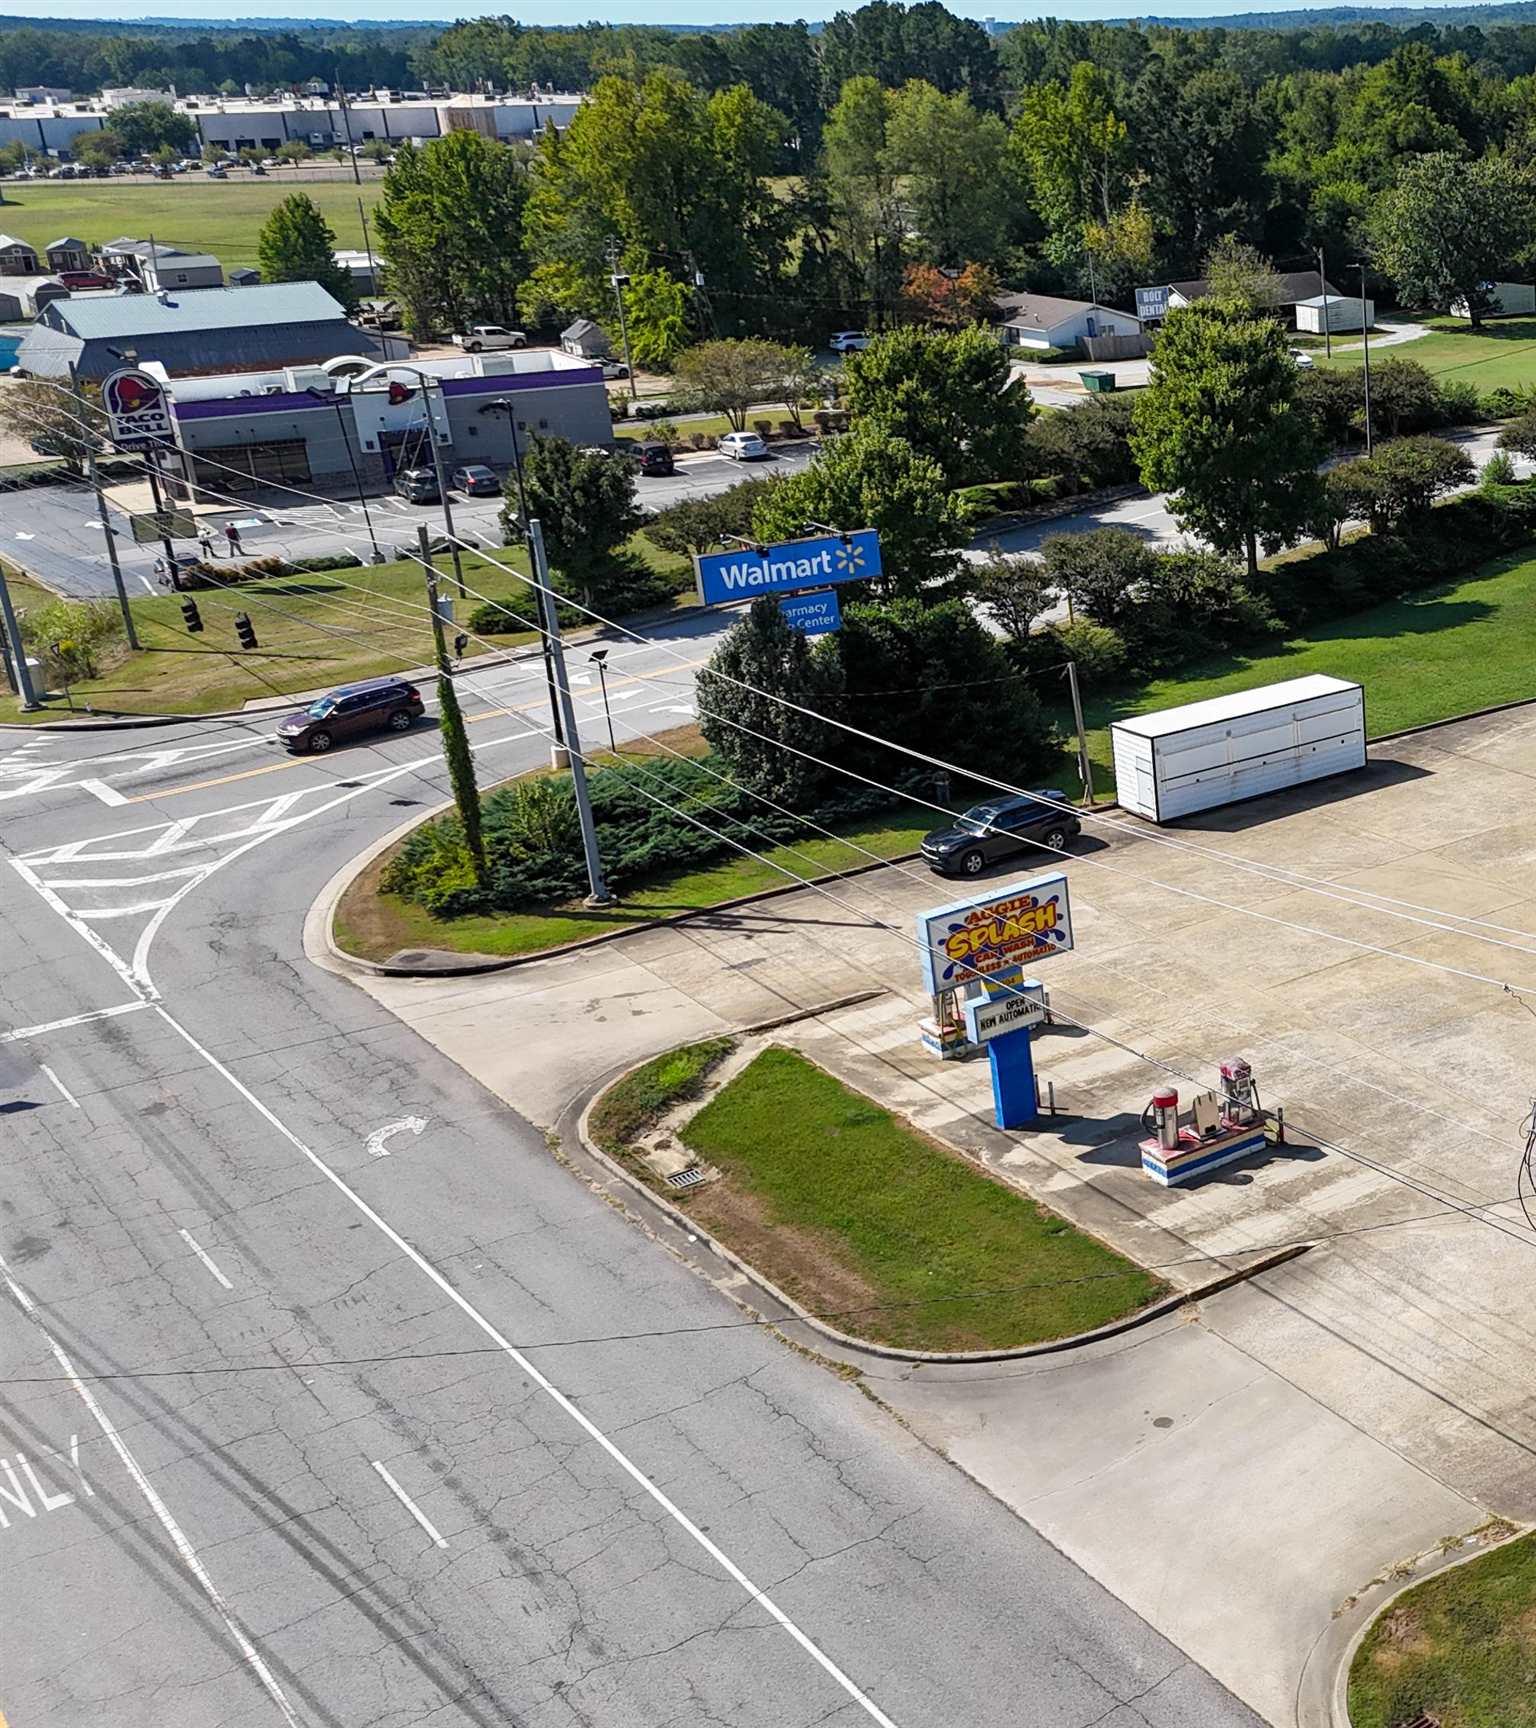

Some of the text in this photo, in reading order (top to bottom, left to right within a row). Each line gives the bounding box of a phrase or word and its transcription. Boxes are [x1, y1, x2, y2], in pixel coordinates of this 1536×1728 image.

[116, 412, 165, 425] TACO
[119, 422, 168, 434] BELL
[720, 550, 832, 589] Walmart
[782, 603, 827, 619] armacy
[797, 616, 835, 628] Center
[945, 901, 1057, 960] SPLASH
[1006, 997, 1026, 1010] OPEN
[0, 1434, 95, 1528] NLY
